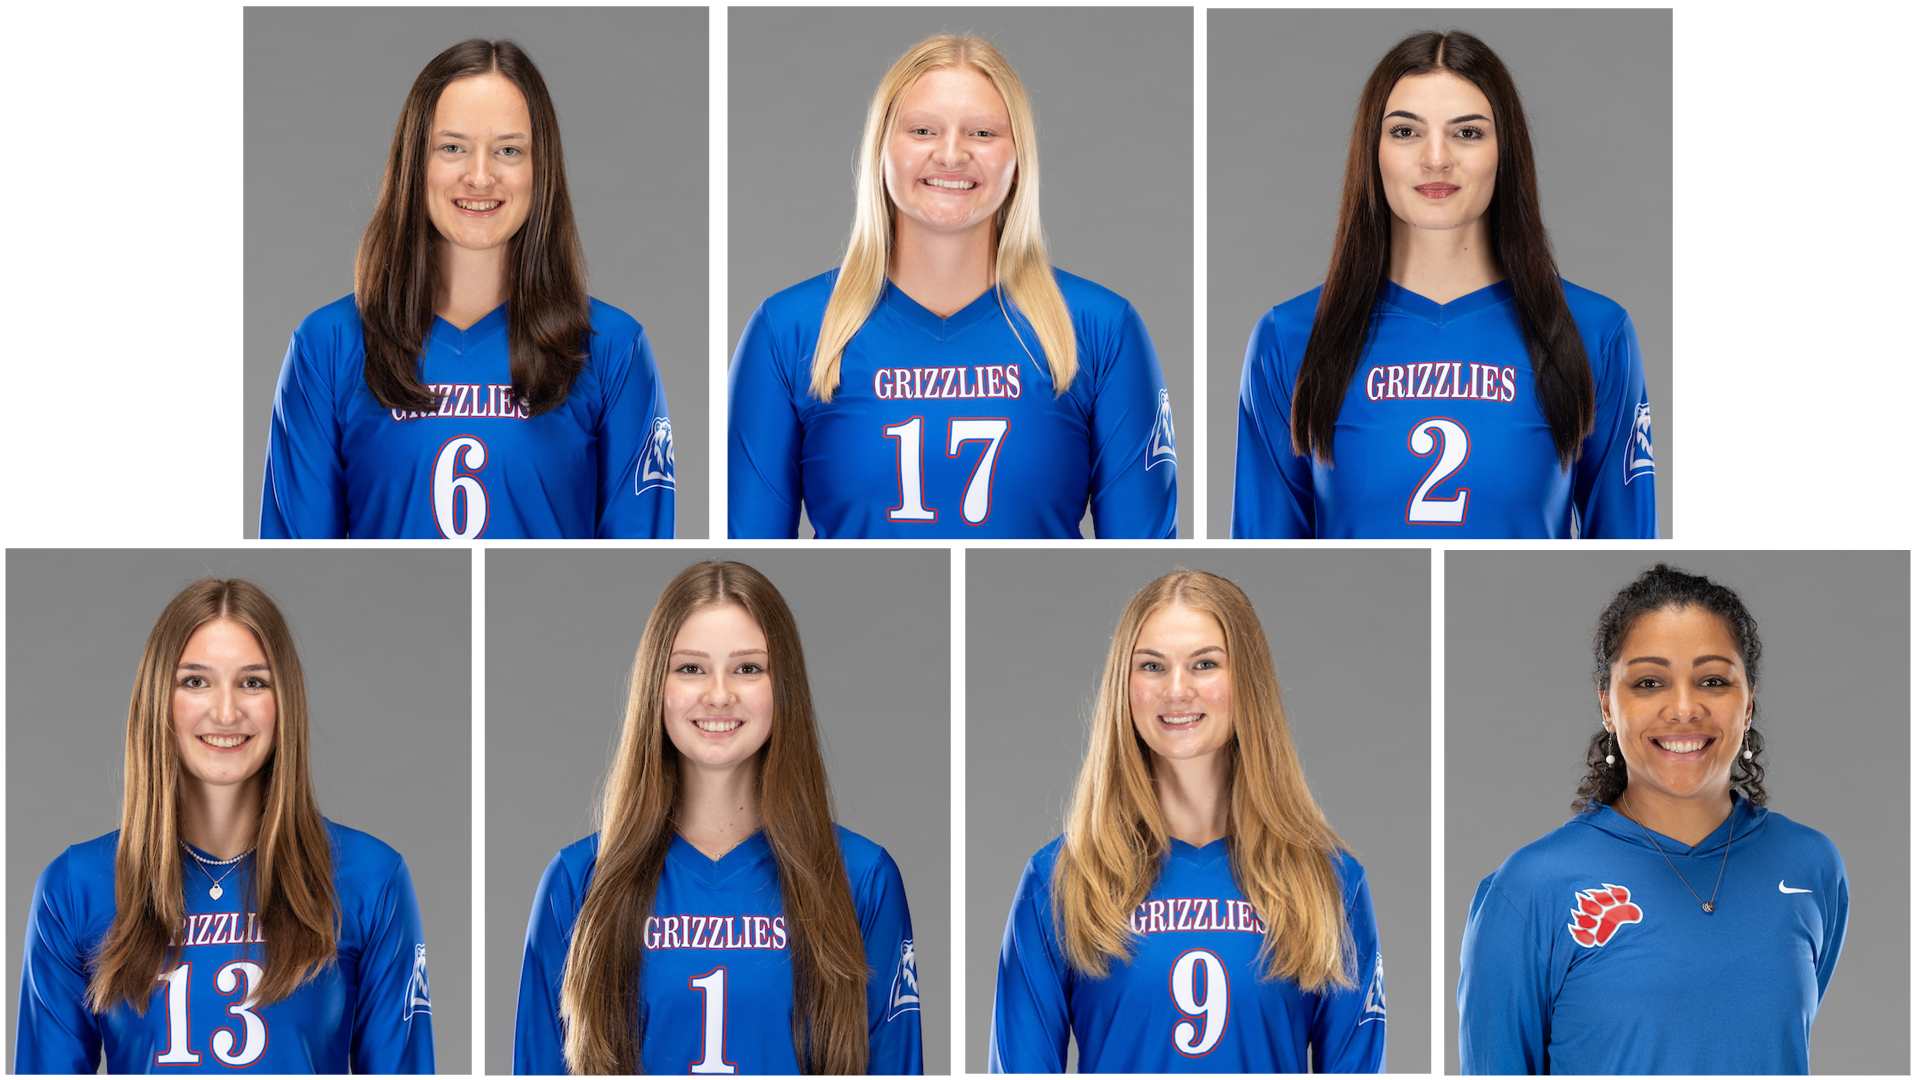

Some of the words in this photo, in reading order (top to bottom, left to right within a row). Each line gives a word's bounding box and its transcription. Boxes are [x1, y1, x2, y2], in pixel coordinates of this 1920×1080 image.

[873, 364, 1022, 400] GRIZZLIES
[1365, 361, 1517, 403] GRIZZLIES
[431, 434, 489, 539] 6
[883, 415, 1011, 526] 17
[1405, 416, 1471, 526] 2
[643, 914, 789, 950] GRIZZLIES
[155, 959, 269, 1068] 13
[689, 966, 738, 1075] 1
[1169, 948, 1230, 1058] 9
